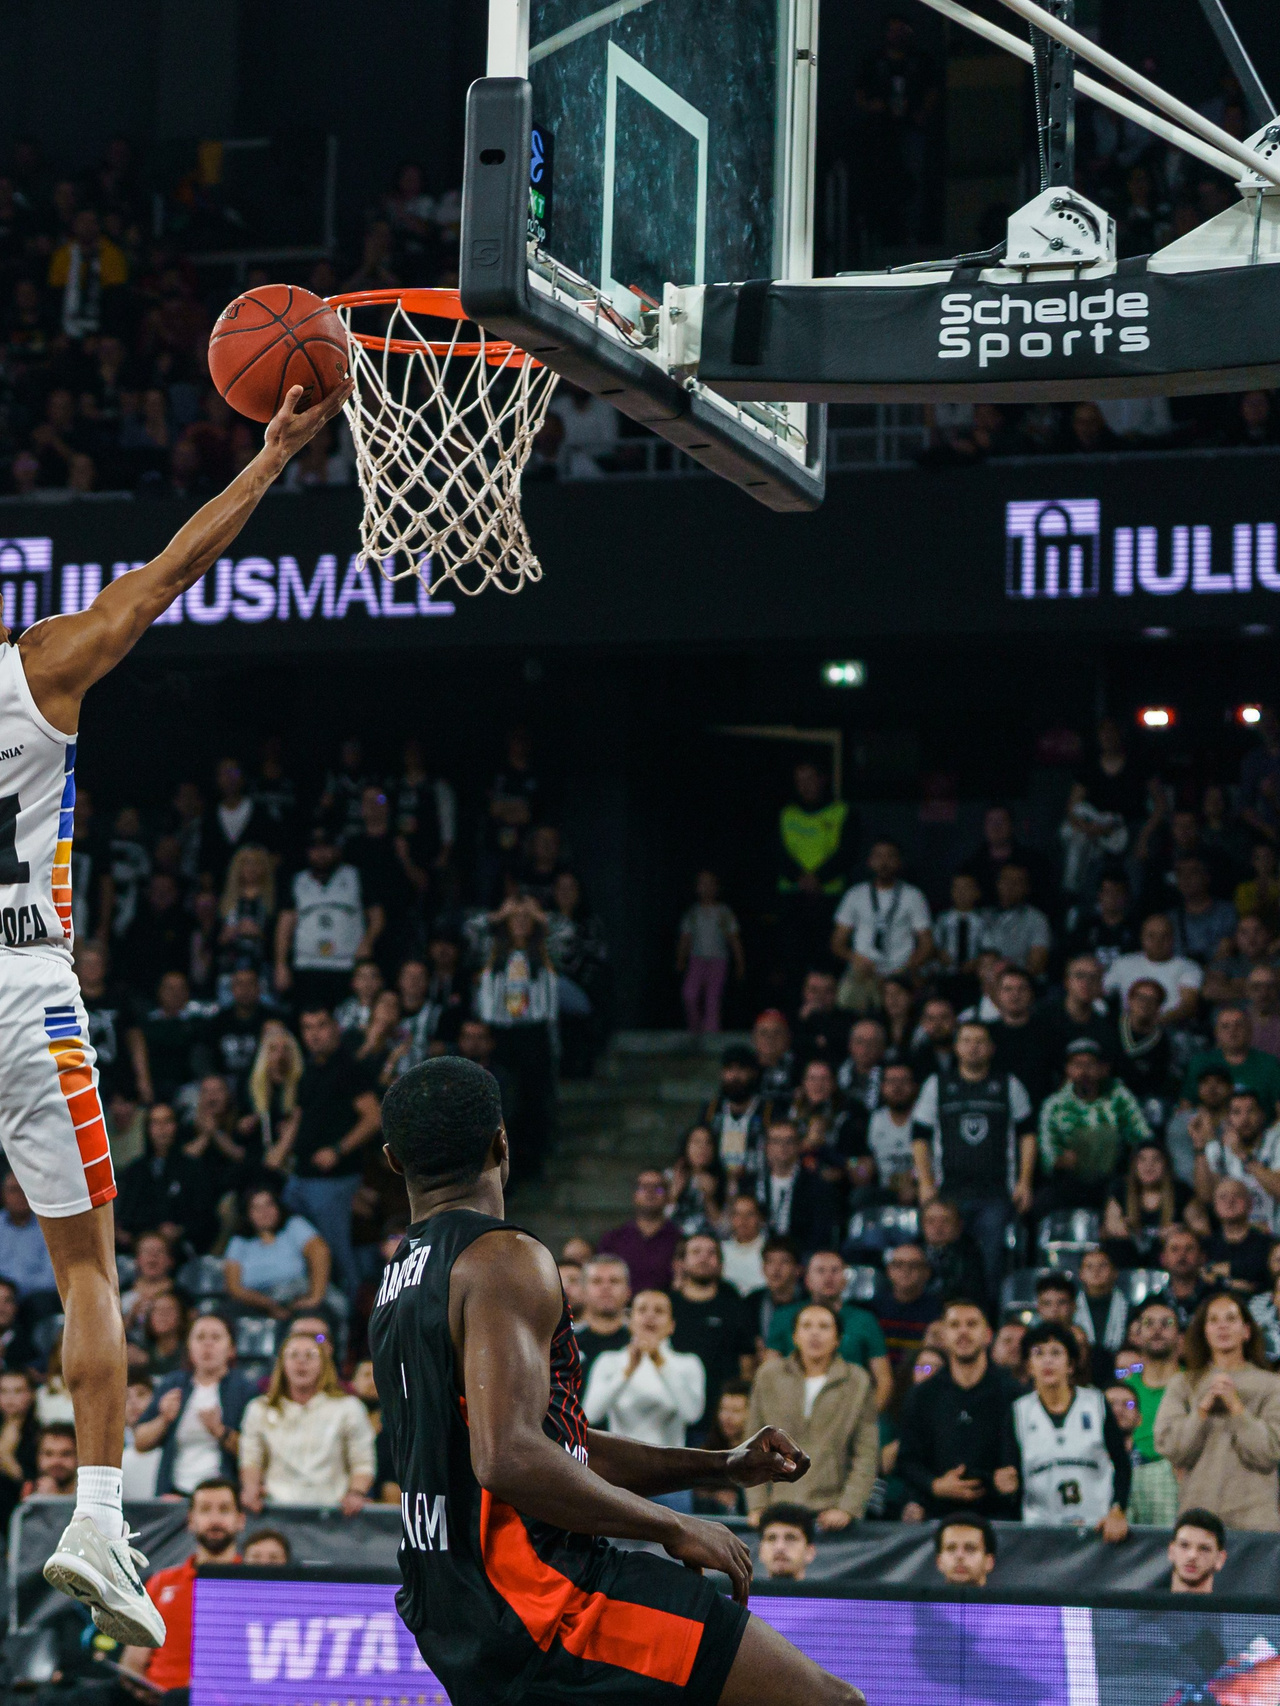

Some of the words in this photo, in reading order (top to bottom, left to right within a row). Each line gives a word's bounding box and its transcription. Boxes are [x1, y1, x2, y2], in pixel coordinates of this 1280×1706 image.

[940, 288, 1149, 325] Schelde
[938, 322, 1151, 367] Sports
[1058, 1481, 1080, 1505] 13
[246, 1612, 400, 1682] WTA
